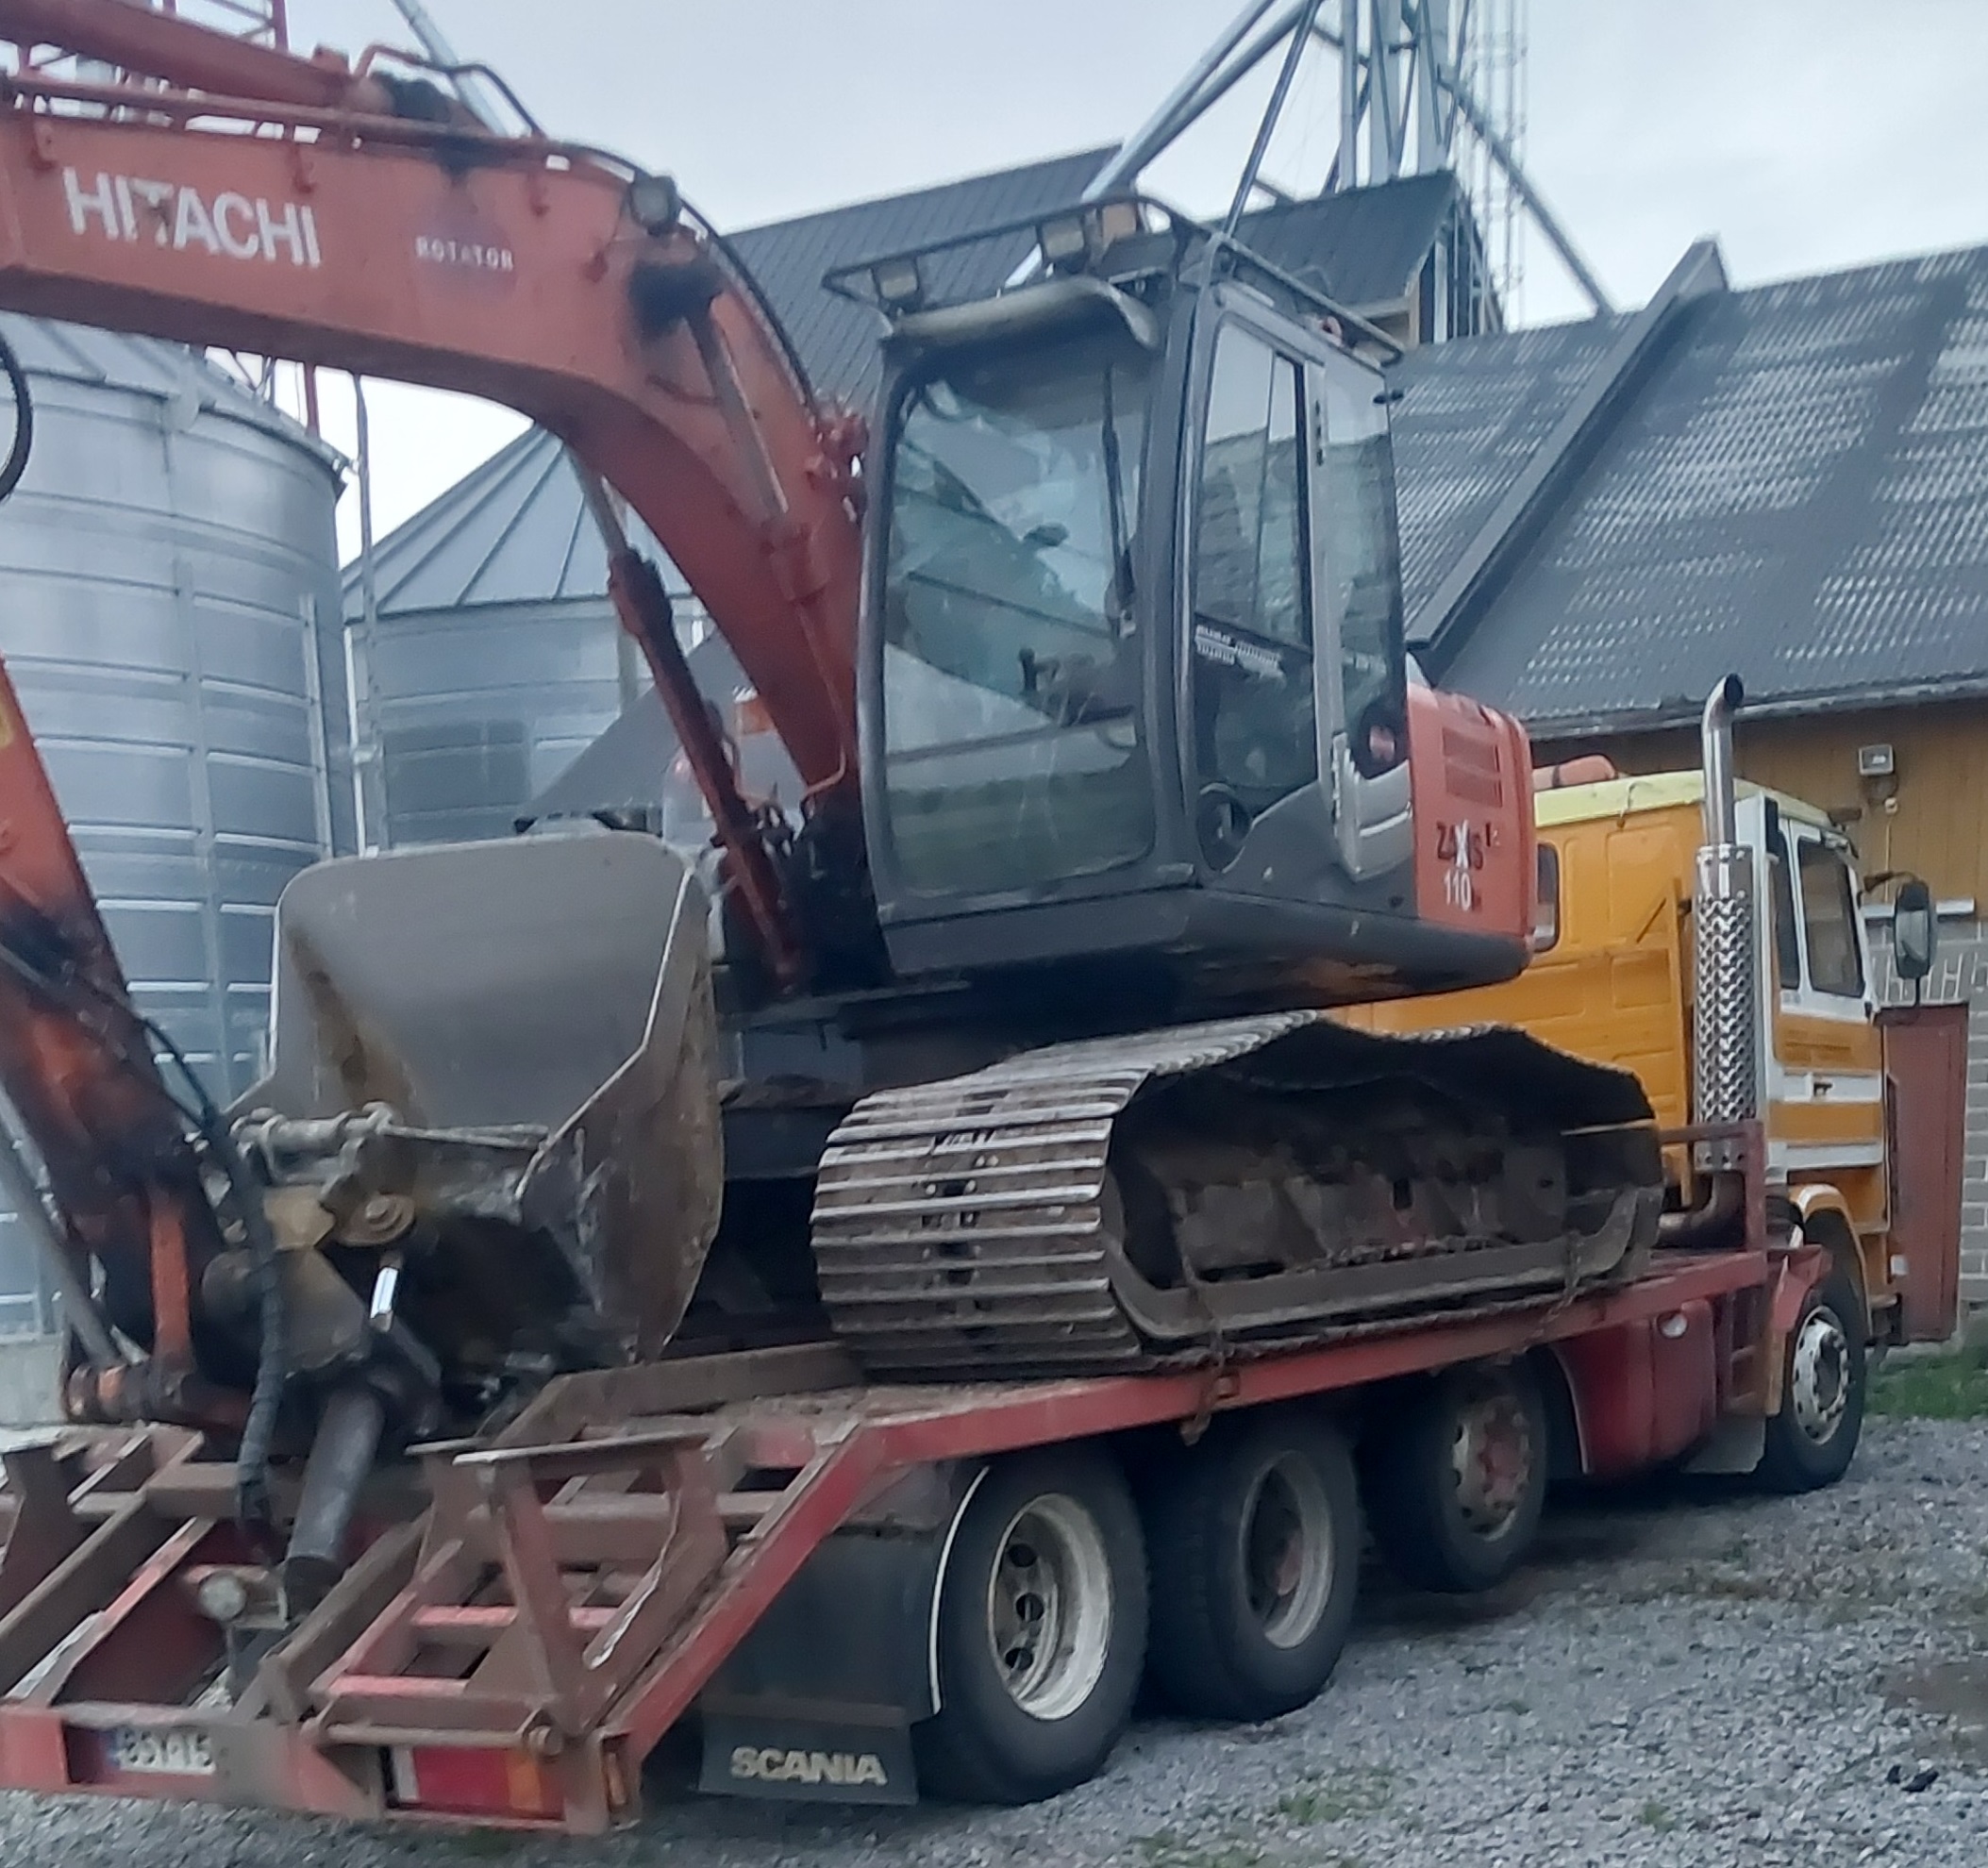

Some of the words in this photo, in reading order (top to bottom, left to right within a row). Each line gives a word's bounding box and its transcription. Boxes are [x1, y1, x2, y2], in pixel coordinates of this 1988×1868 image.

[62, 166, 321, 268] HITACHI
[1444, 869, 1472, 911] 110
[731, 1746, 888, 1786] SCANIA
